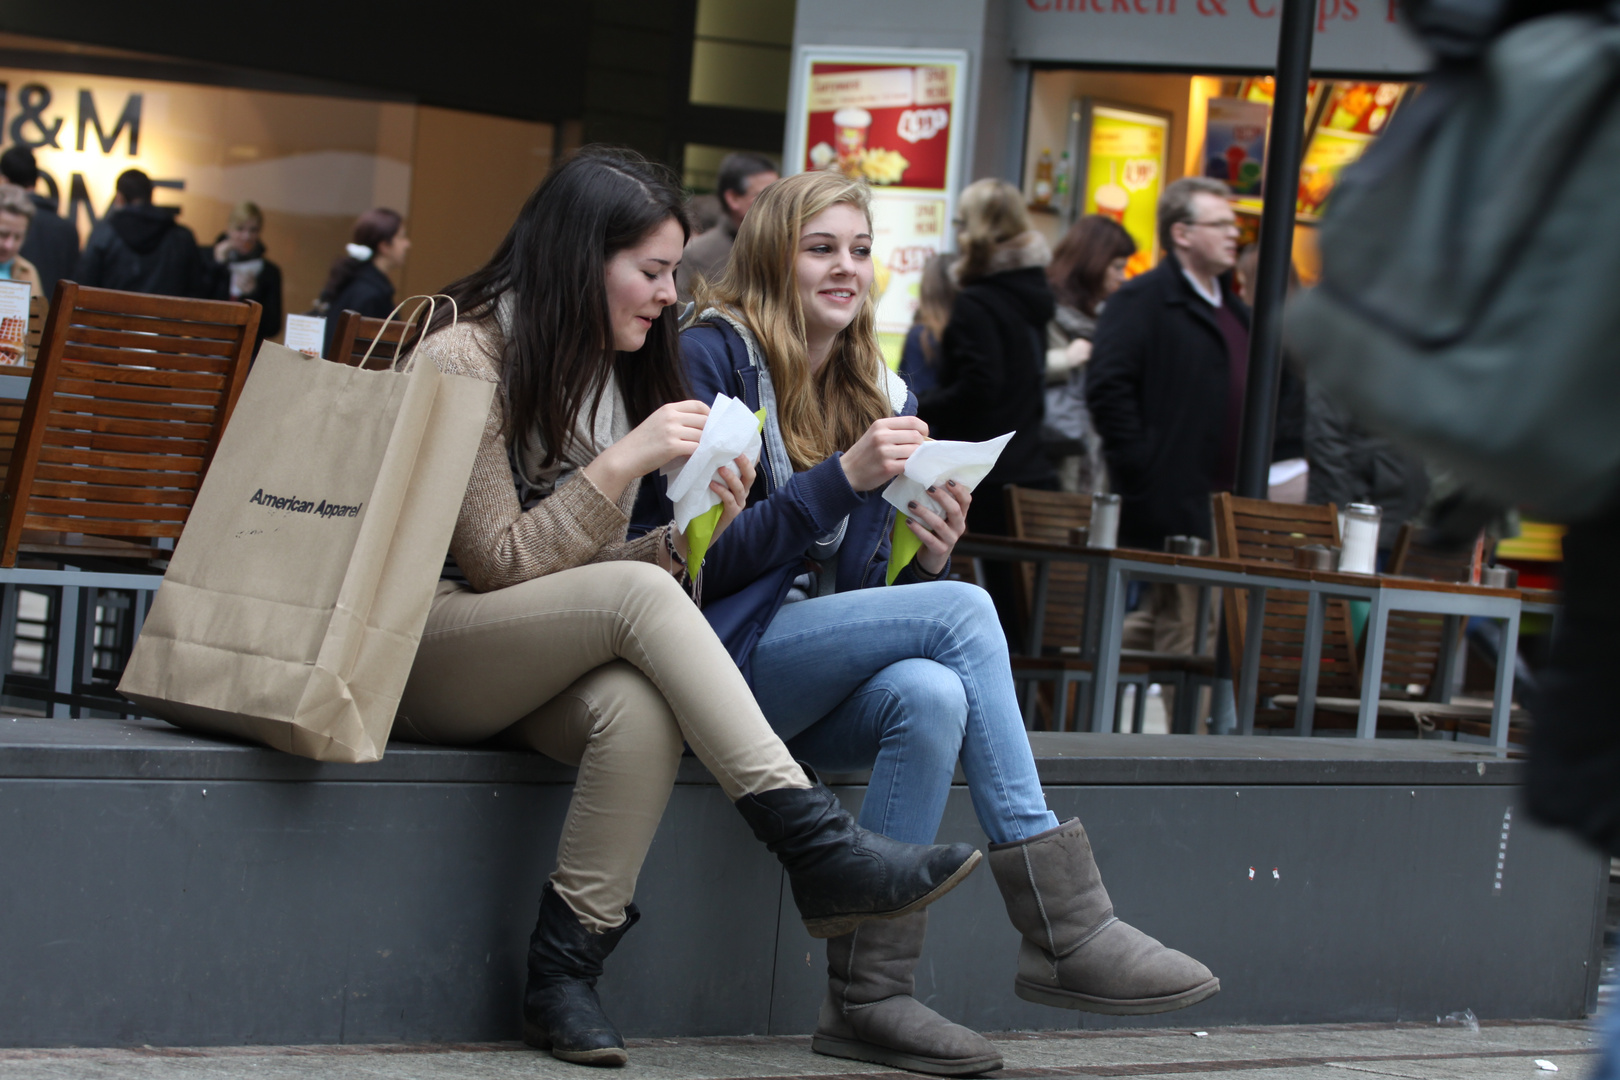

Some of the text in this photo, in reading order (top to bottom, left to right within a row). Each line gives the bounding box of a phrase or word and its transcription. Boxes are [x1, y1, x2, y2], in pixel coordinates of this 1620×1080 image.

[0, 82, 144, 156] &M
[249, 488, 363, 519] American Apparel
